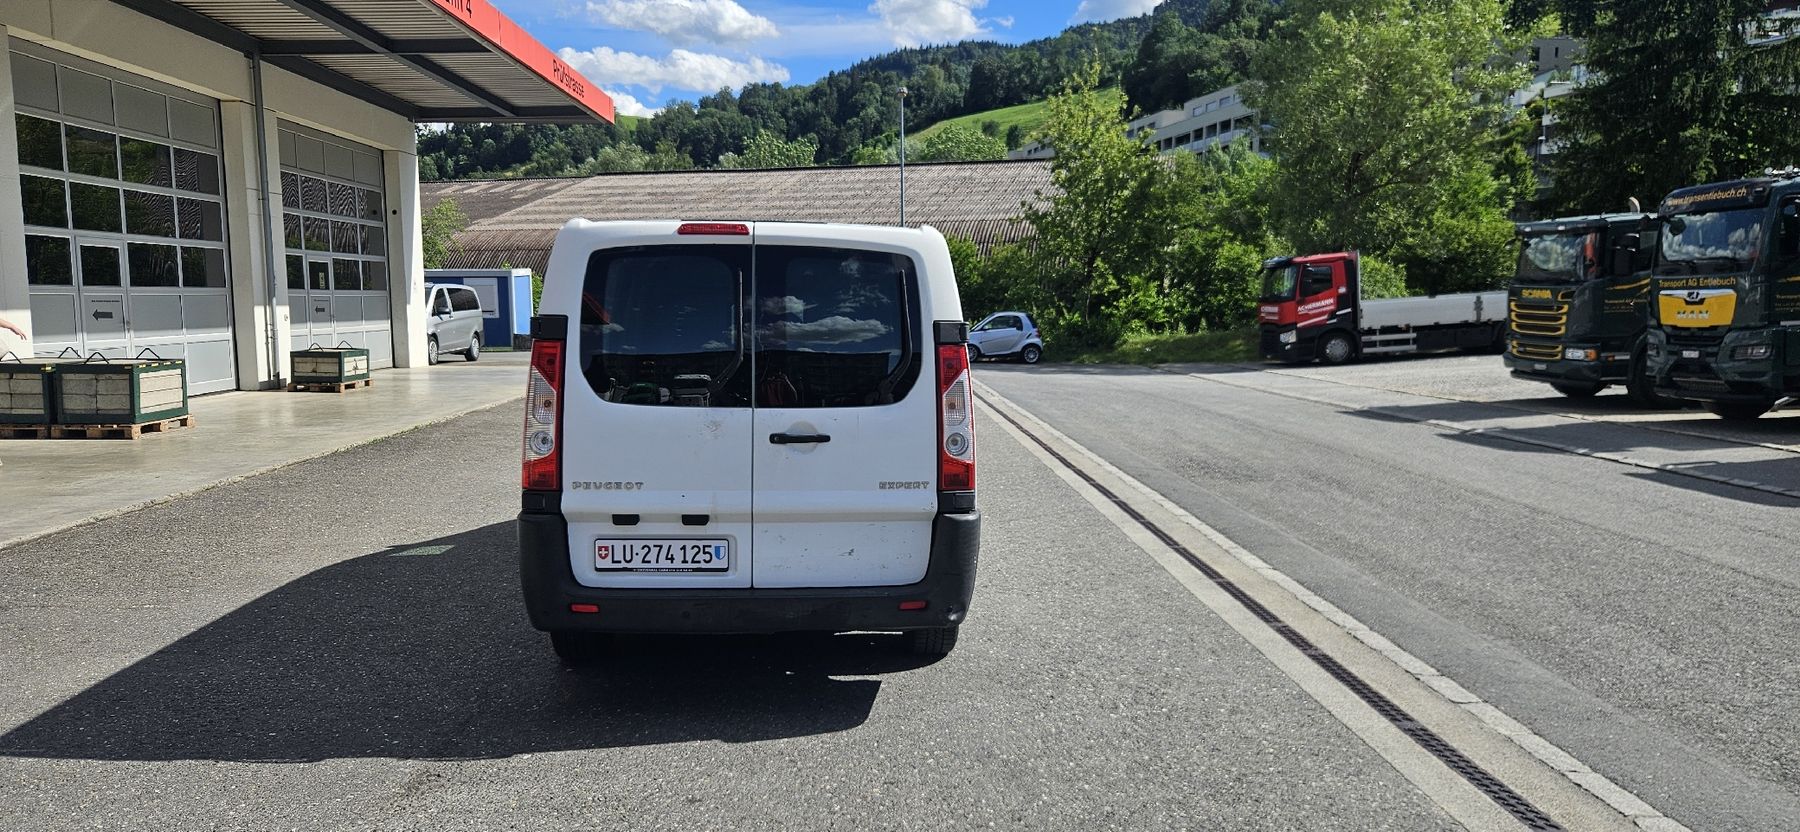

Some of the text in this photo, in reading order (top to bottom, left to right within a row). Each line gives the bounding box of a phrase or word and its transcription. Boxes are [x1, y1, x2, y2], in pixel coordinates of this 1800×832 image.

[552, 59, 585, 98] Prüfstrasse
[1667, 187, 1747, 206] www.transentlebuch.ch
[1659, 277, 1736, 288] Transport AG Entlebuch
[1521, 289, 1552, 299] SCANIA
[1676, 309, 1711, 320] MAN
[571, 481, 645, 490] PEUGEOT
[878, 481, 931, 490] EXPERT
